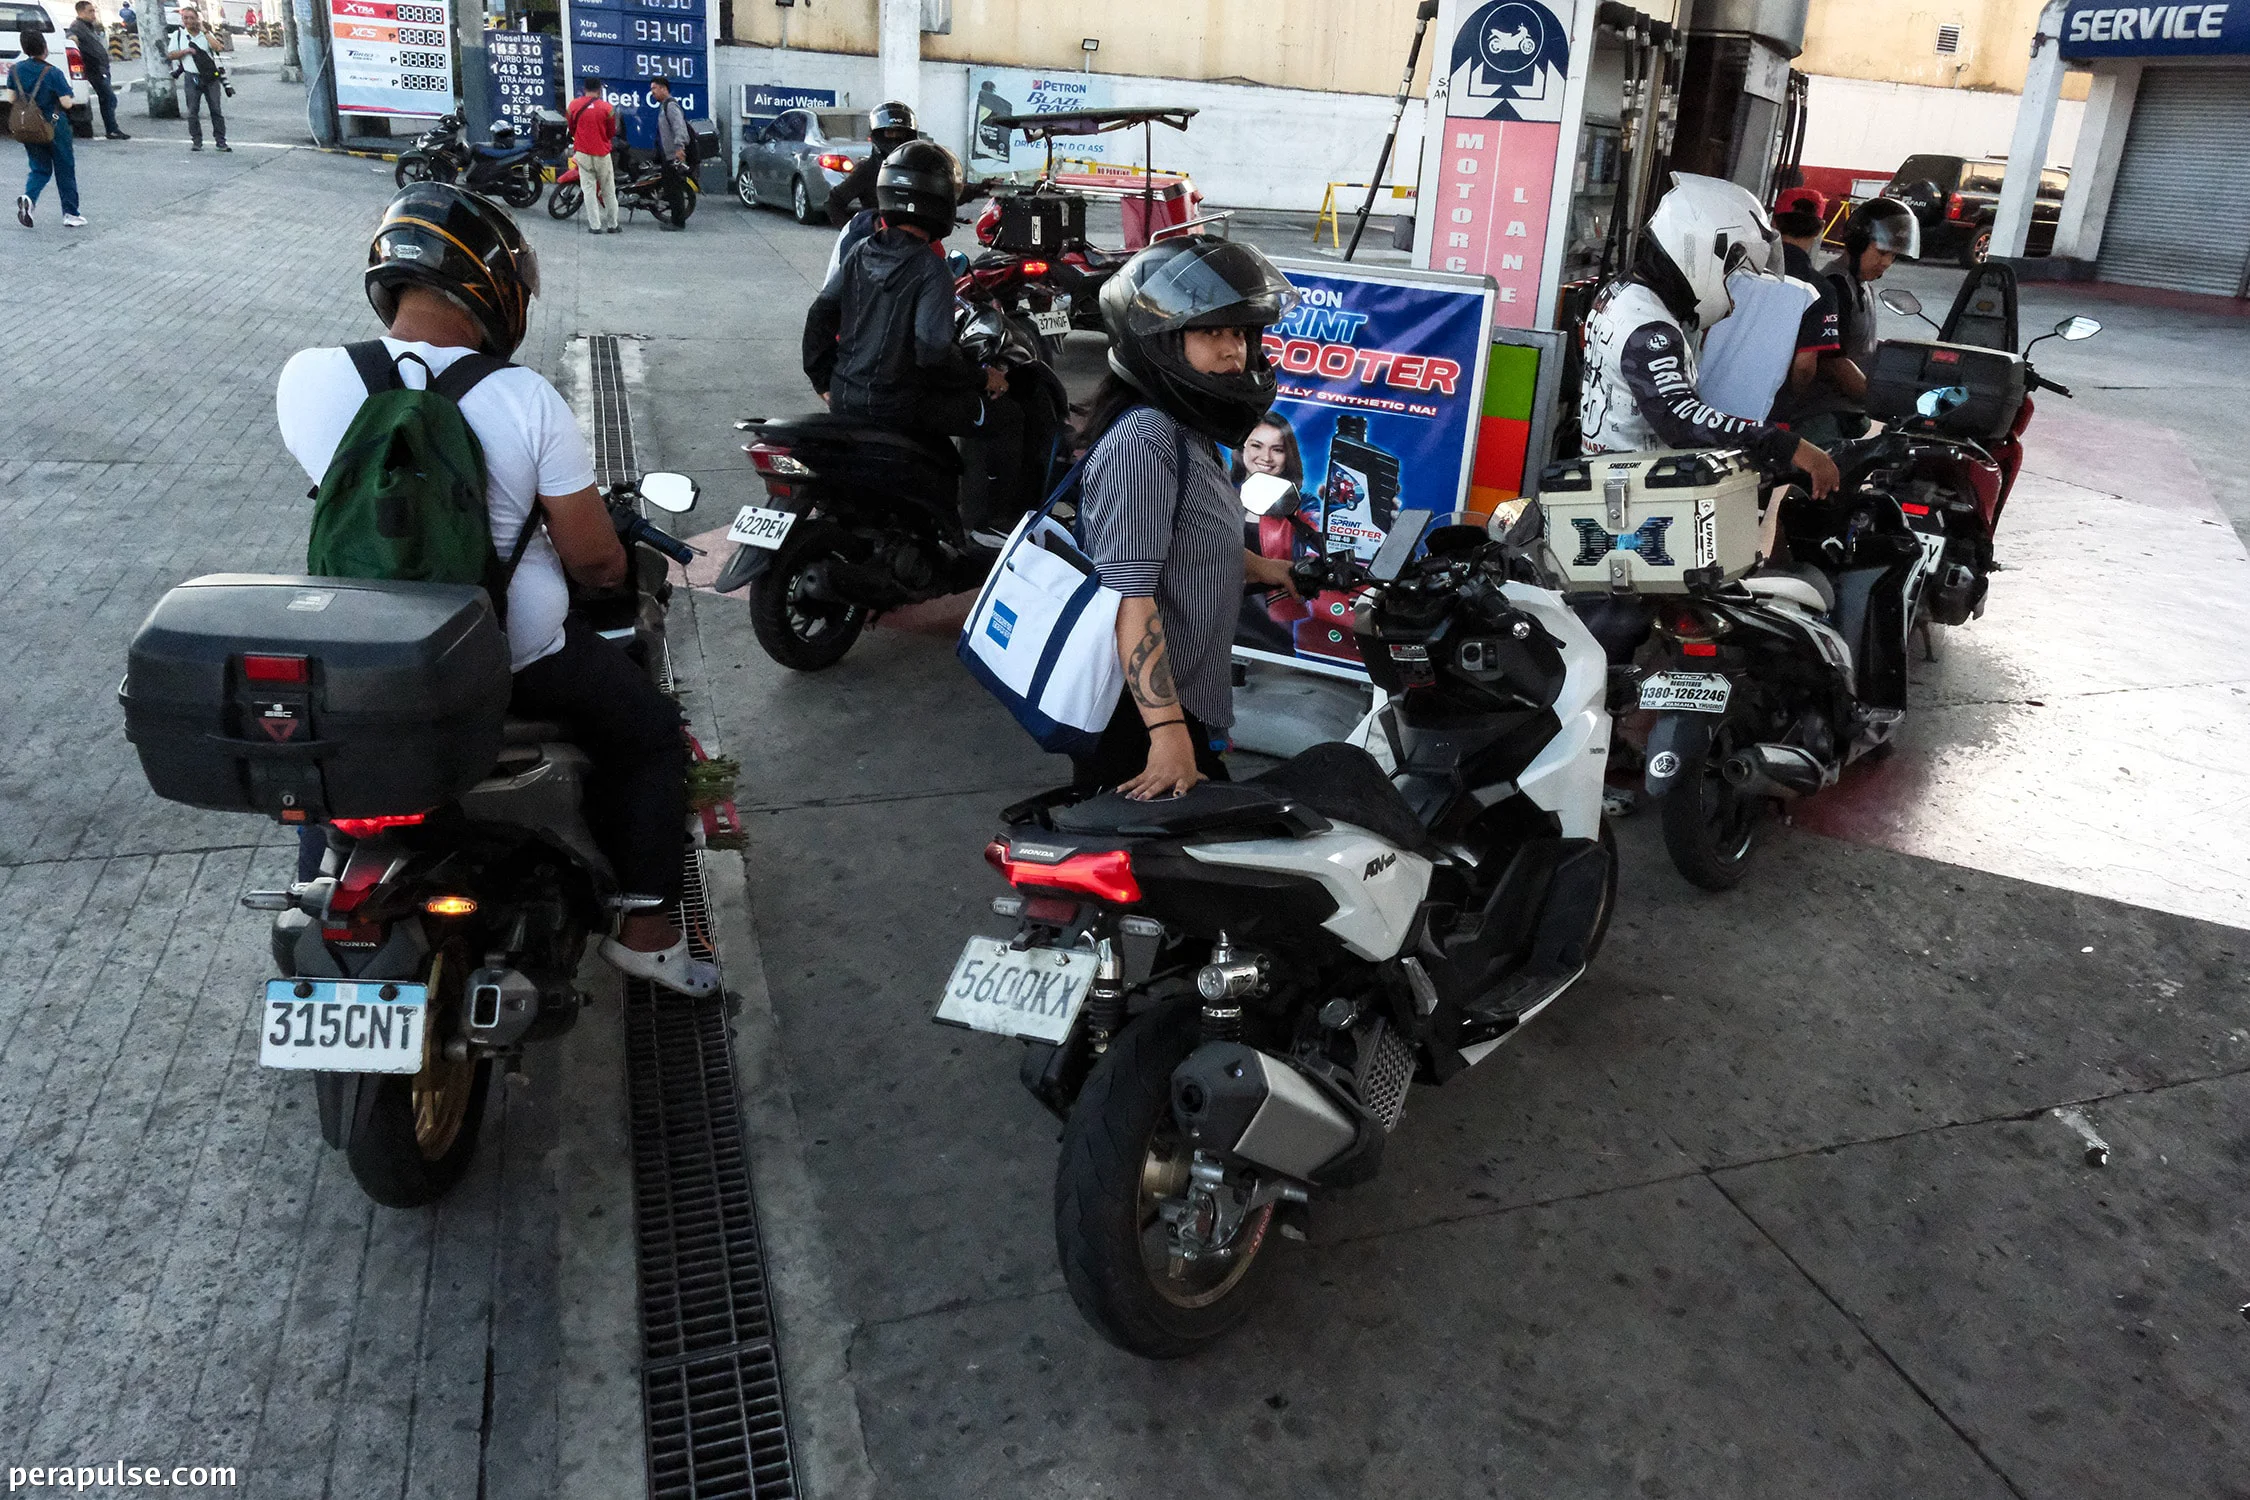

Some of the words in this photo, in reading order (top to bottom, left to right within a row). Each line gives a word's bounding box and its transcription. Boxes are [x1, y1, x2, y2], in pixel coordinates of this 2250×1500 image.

[343, 2, 375, 15] XTRA
[2069, 4, 2229, 42] SERVICE
[350, 27, 377, 38] XCS
[495, 34, 520, 43] Diesel
[522, 35, 542, 43] MAX
[580, 19, 598, 28] Xtra
[635, 20, 692, 44] 93.40
[580, 30, 617, 39] Advance
[497, 55, 521, 64] TURBO
[523, 56, 544, 65] Diesel
[582, 64, 600, 73] XCS
[636, 54, 693, 78] 95.40
[490, 64, 542, 76] 148.30
[498, 76, 517, 84] XTRA
[517, 76, 545, 85] Advance
[1043, 80, 1087, 94] PETRON
[501, 84, 544, 96] 93.40
[512, 96, 531, 104] XCS
[602, 84, 640, 107] leet
[646, 90, 694, 111] Crd
[754, 93, 773, 106] Air
[774, 95, 794, 107] and
[795, 95, 829, 108] Water
[1027, 91, 1085, 105] BLAZE
[513, 116, 532, 124] Blaz
[1014, 140, 1043, 149] DRIVE
[1076, 143, 1104, 153] CLASS
[1445, 133, 1485, 273] MOTORC
[1500, 187, 1528, 304] LANE
[1272, 305, 1368, 343] RINT
[1262, 333, 1461, 394] COOTER
[1277, 384, 1313, 397] ULLY
[1316, 391, 1405, 411] SYNTHETIC
[1409, 404, 1437, 416] NA!
[734, 514, 789, 540] 422PEW
[1330, 518, 1362, 528] SPRINT
[1329, 526, 1382, 539] SCOOTER
[1643, 687, 1726, 701] 1380-1262246
[1019, 848, 1054, 858] HONDA
[269, 1002, 418, 1050] 315CNT
